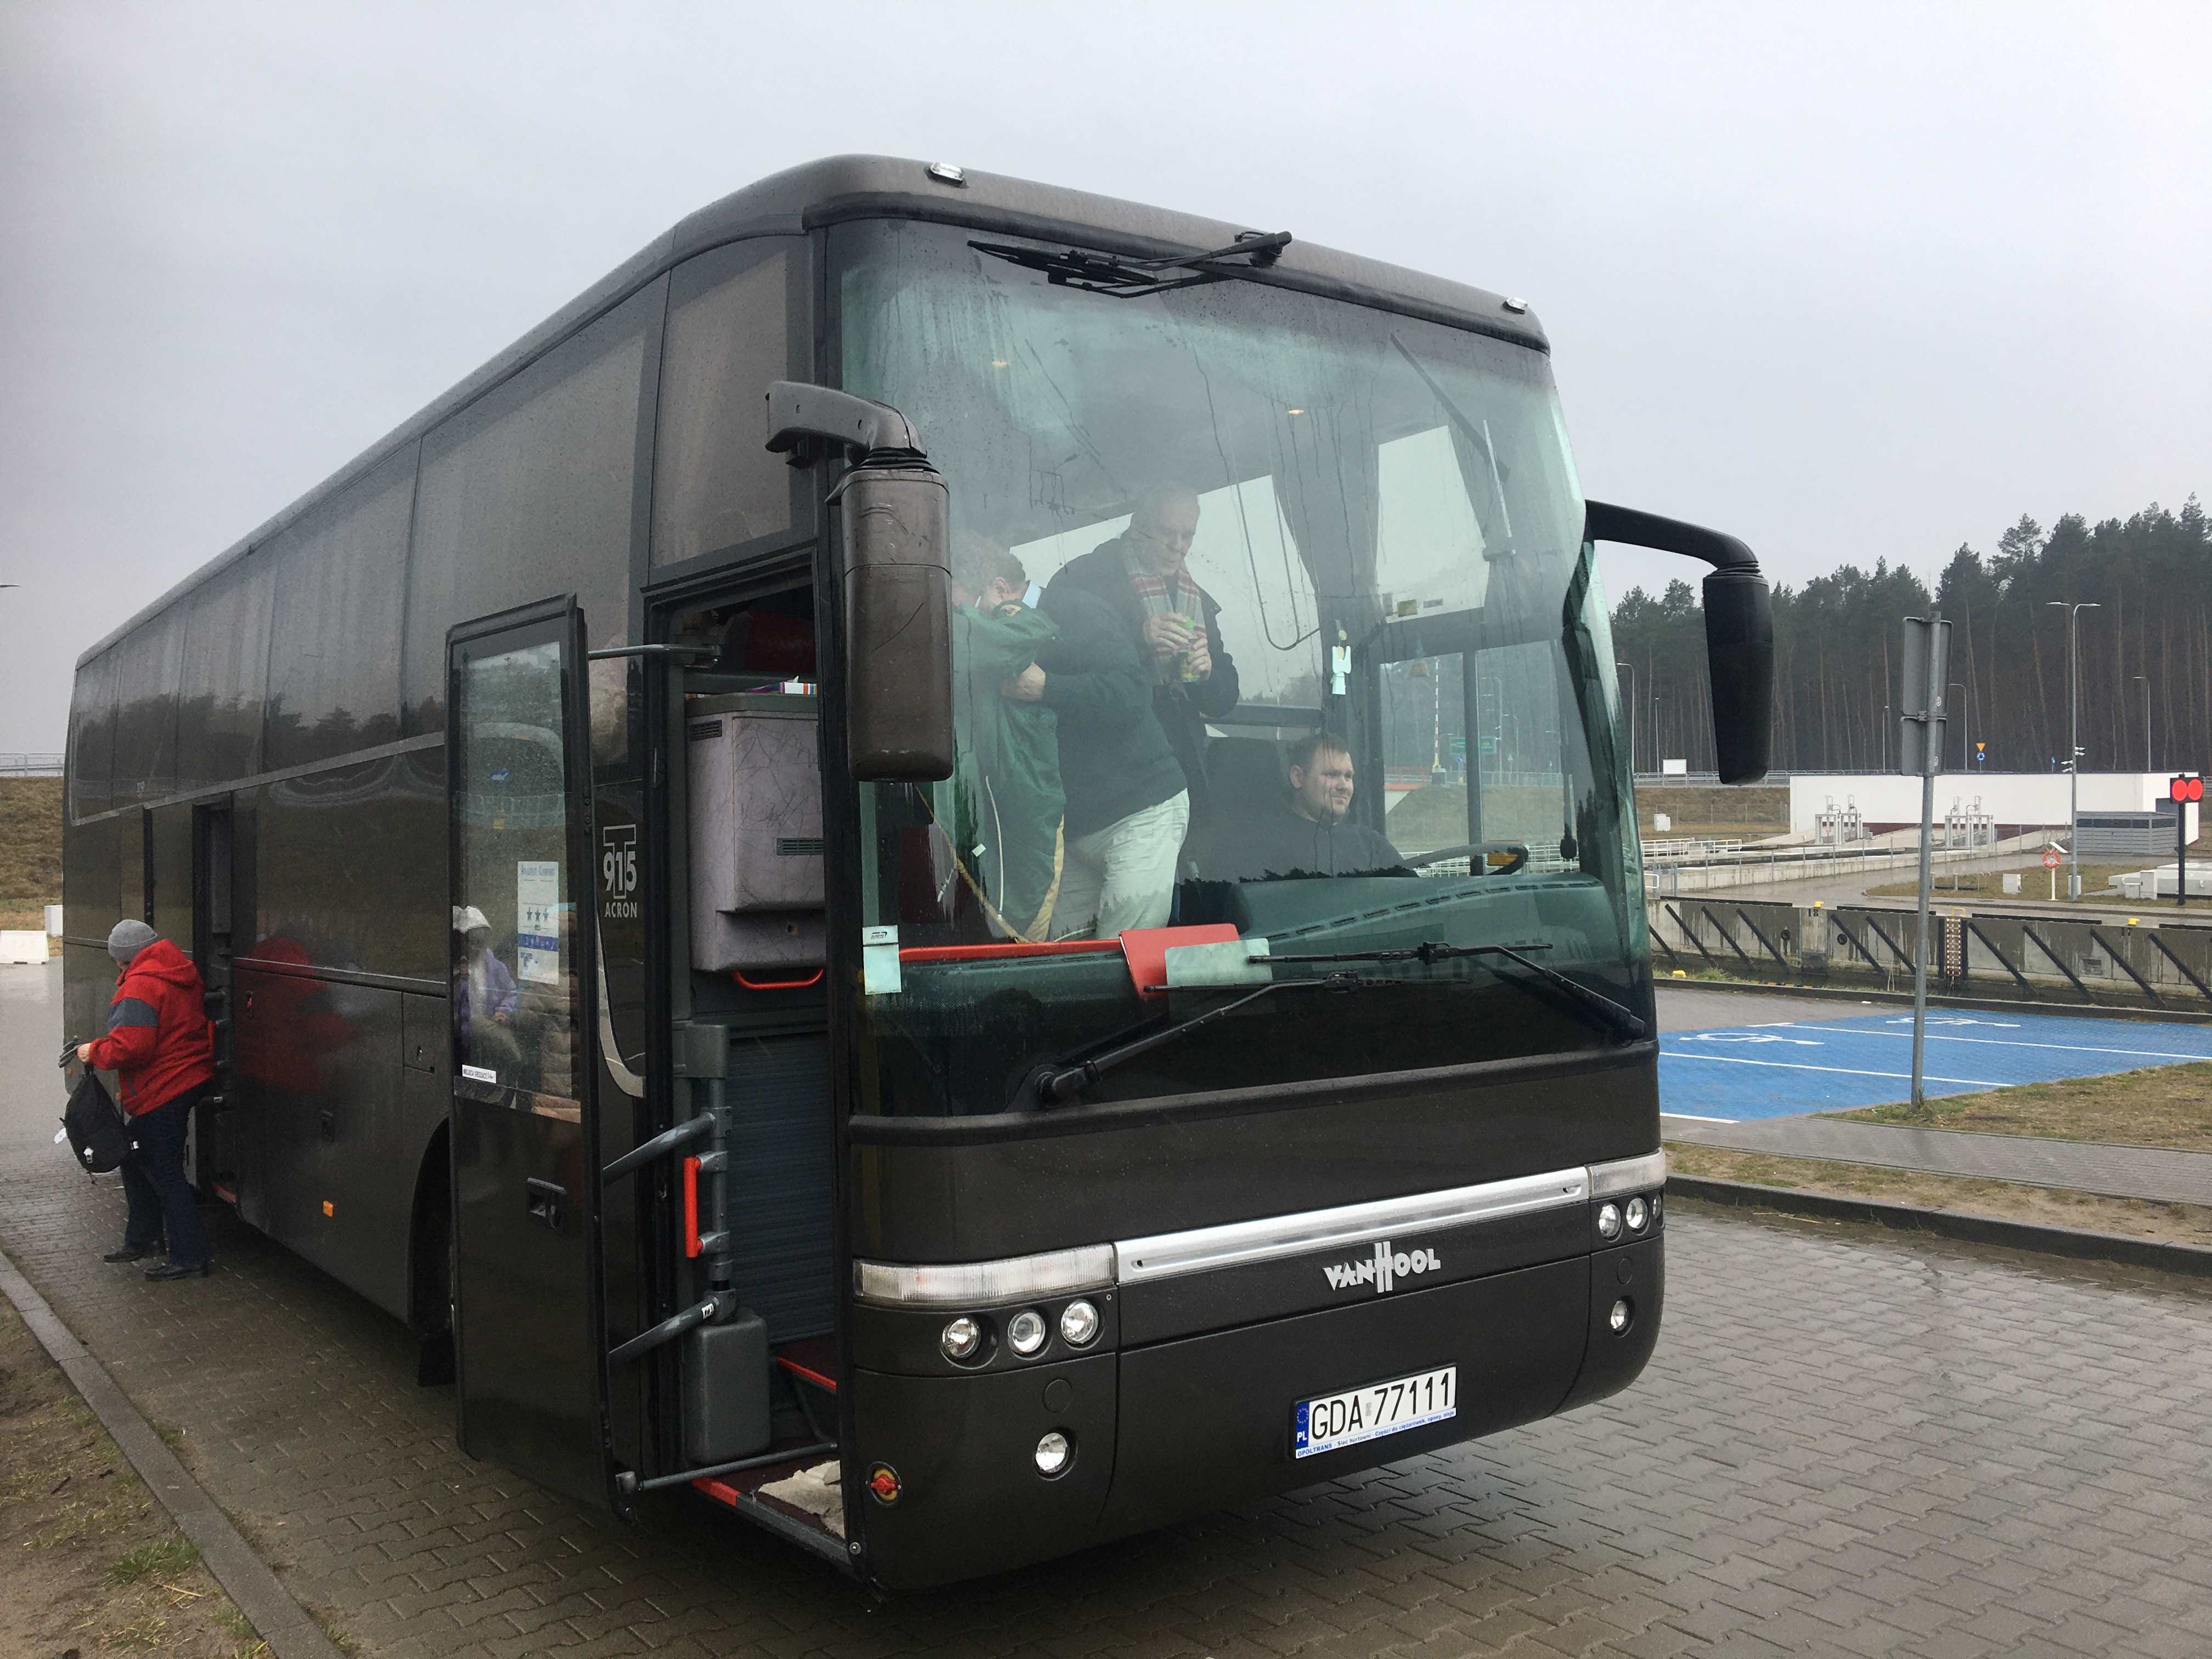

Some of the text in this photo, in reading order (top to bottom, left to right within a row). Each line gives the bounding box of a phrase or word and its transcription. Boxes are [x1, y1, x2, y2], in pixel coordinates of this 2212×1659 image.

[603, 851, 637, 891] 915
[605, 901, 637, 918] ACRON
[1312, 1372, 1449, 1440] GDA 77111
[1296, 1431, 1307, 1443] PL
[1297, 1443, 1332, 1457] OPOLTRANS
